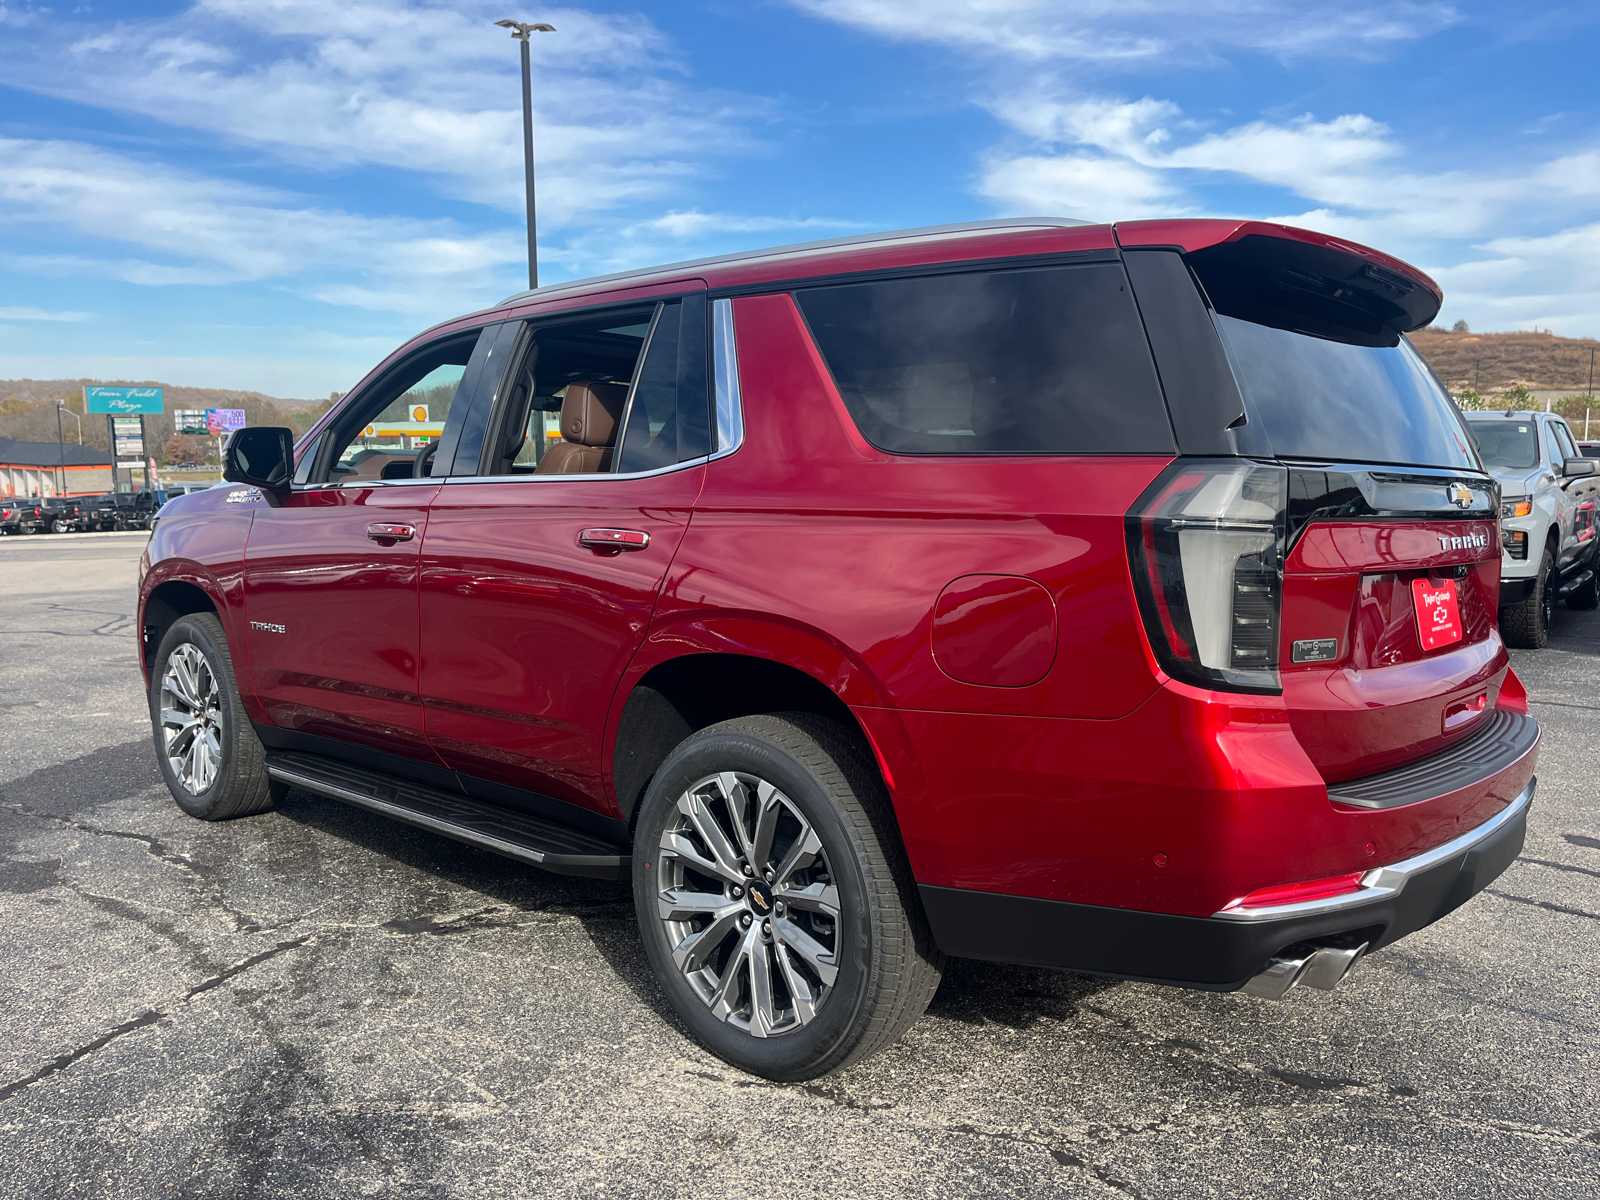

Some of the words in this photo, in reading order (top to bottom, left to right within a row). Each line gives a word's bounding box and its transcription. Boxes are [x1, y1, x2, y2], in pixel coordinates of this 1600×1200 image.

[91, 387, 121, 397] Town
[126, 388, 158, 399] Field
[1437, 534, 1487, 550] TAHOE
[249, 620, 286, 634] TAHOE
